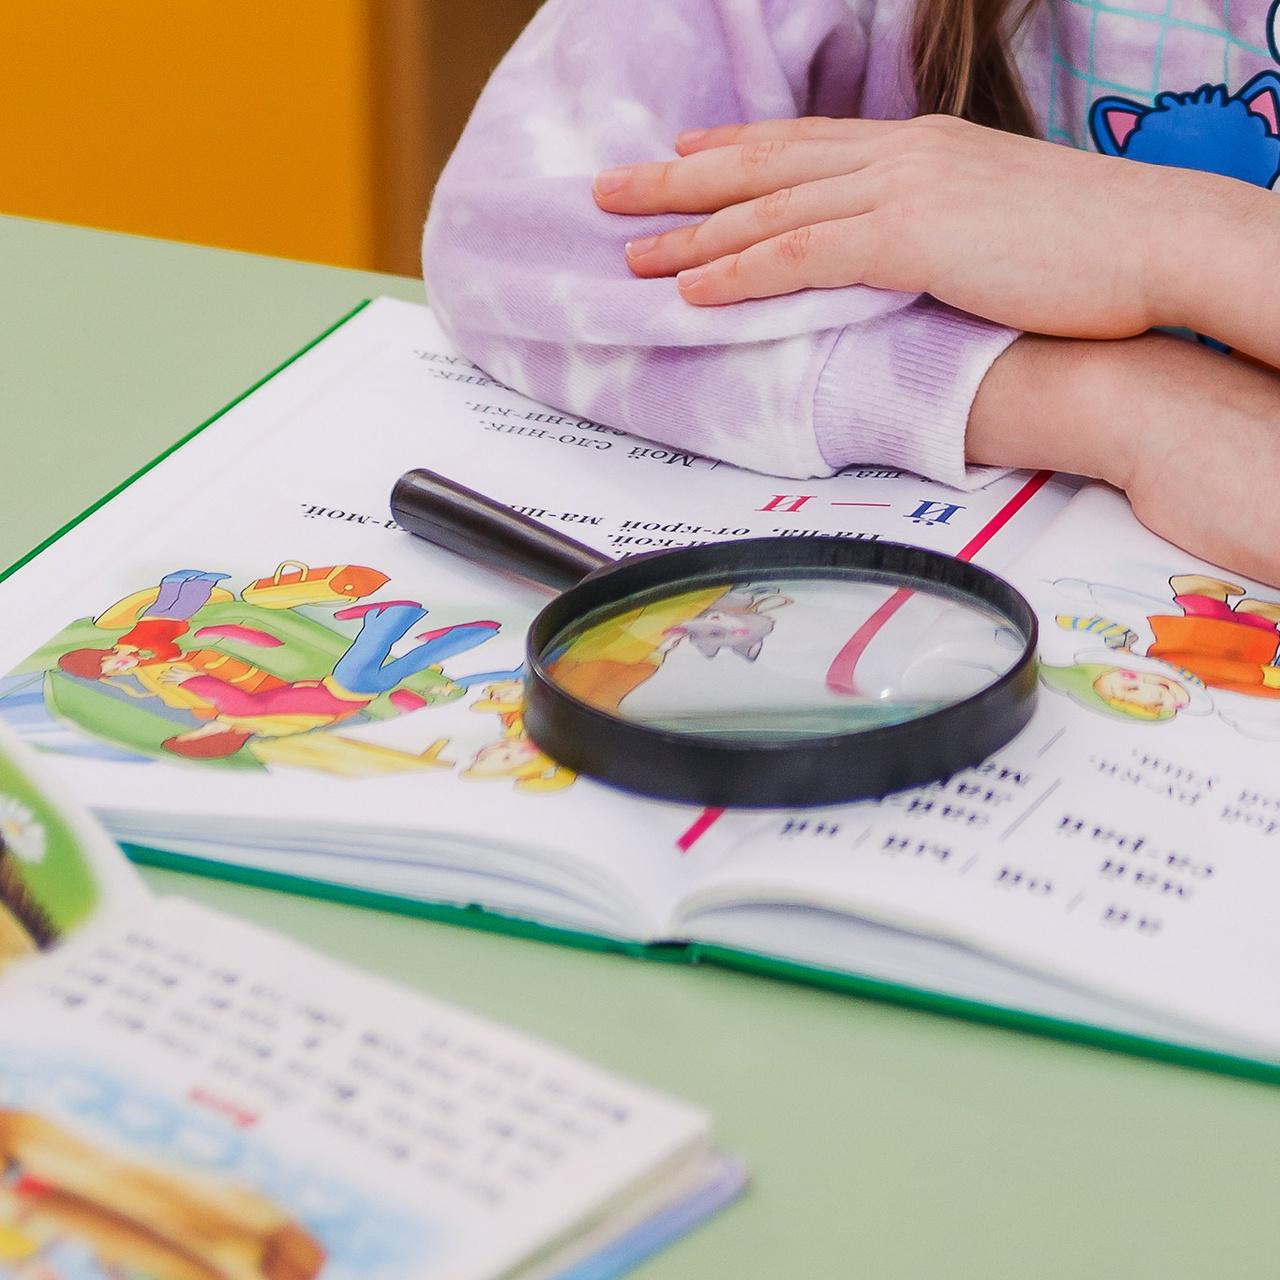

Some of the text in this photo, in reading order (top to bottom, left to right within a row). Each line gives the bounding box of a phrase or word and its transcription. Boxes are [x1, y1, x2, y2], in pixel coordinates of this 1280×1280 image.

[754, 495, 818, 513] И
[903, 500, 966, 526] Й
[300, 503, 408, 532] а-мой.
